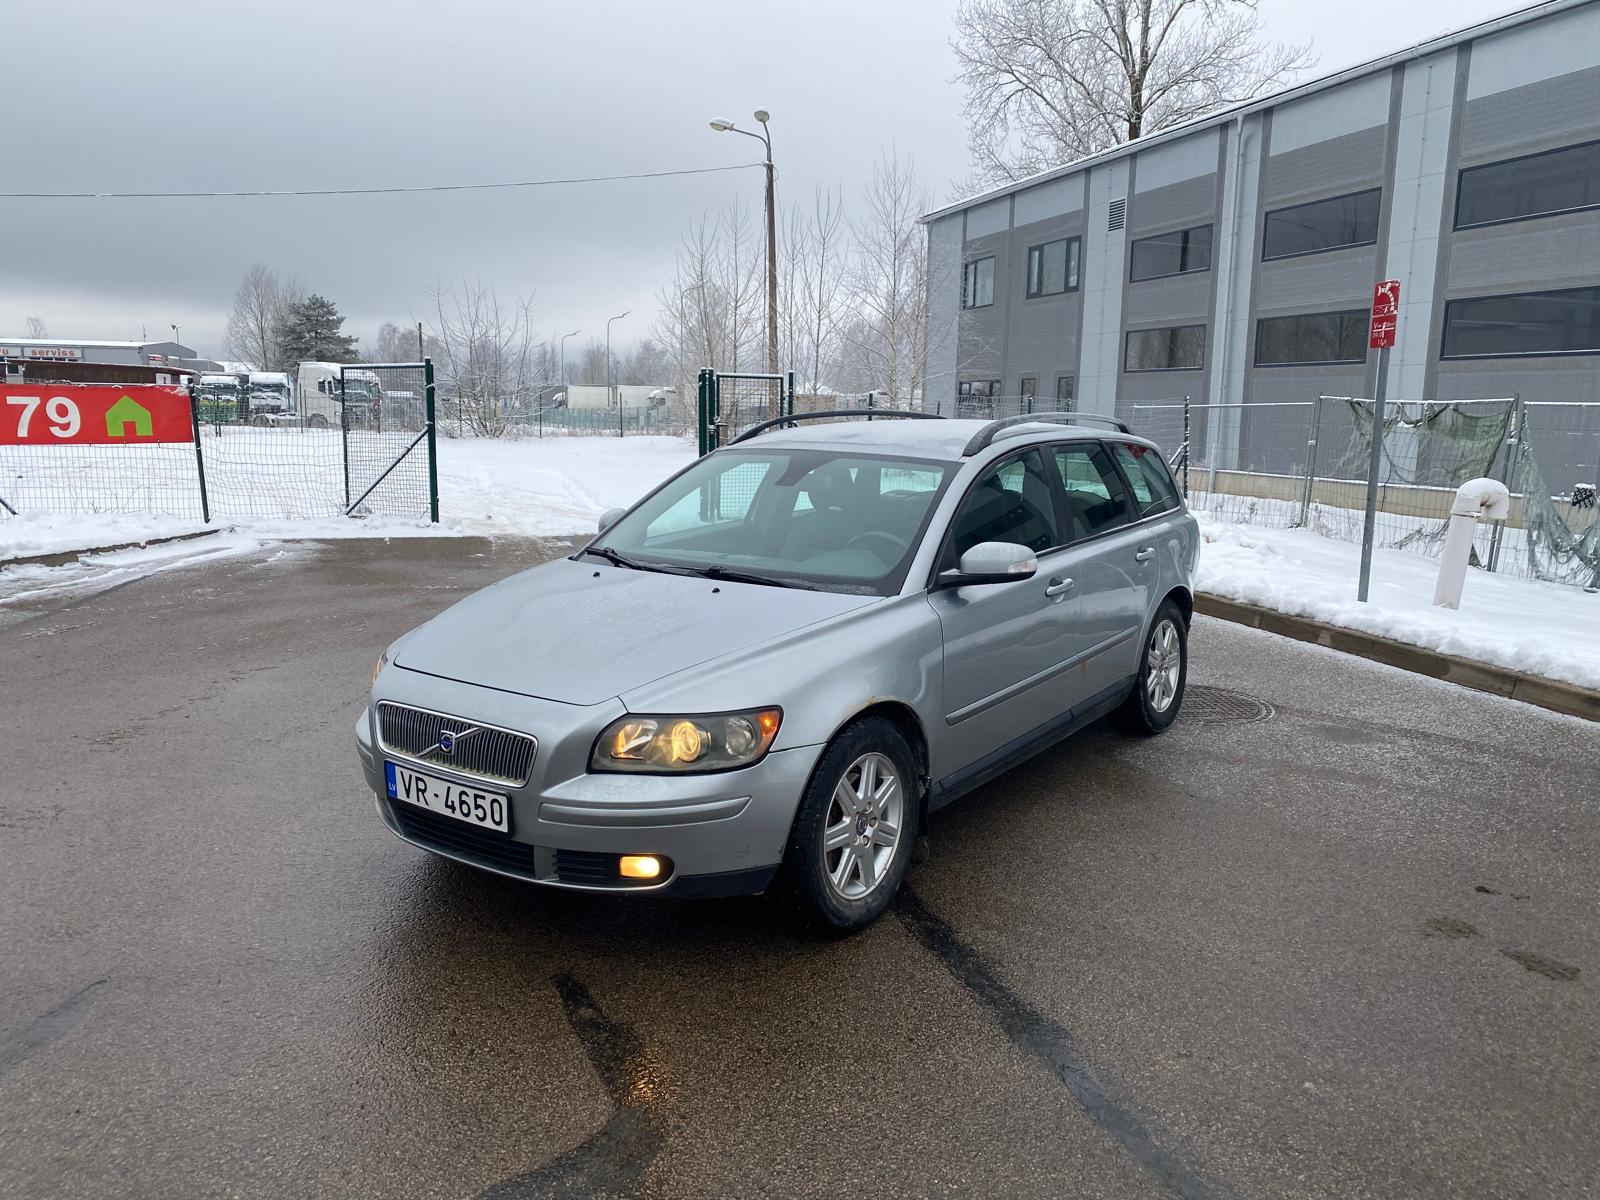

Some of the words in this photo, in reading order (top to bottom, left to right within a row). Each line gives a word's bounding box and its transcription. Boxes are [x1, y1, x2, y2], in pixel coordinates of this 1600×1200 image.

[31, 348, 75, 356] serviss
[6, 396, 81, 438] 79
[388, 782, 396, 791] LV
[400, 771, 503, 827] VR-4650
